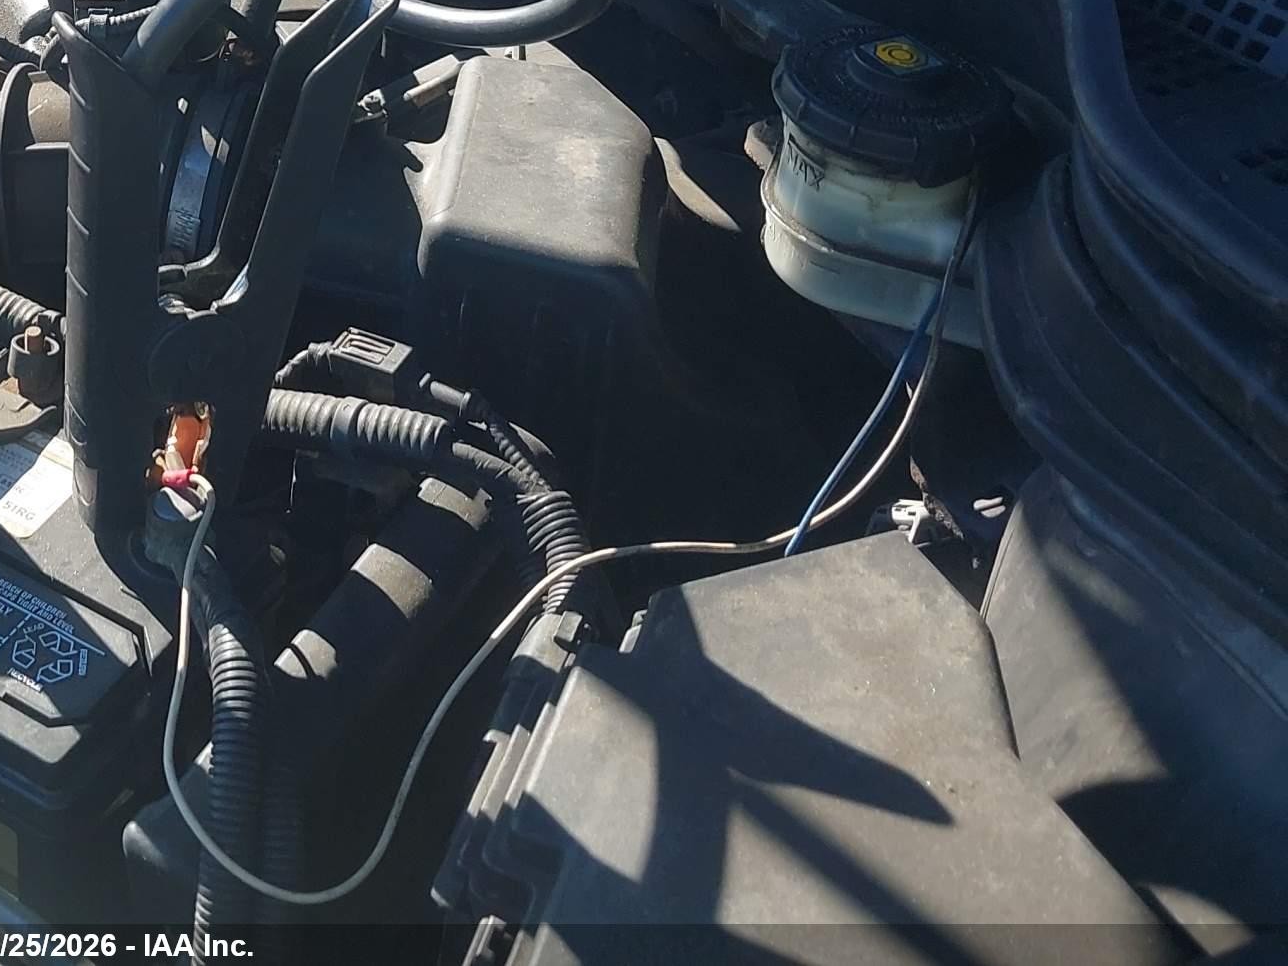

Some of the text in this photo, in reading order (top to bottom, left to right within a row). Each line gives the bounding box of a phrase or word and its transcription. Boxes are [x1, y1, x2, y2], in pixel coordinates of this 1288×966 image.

[2, 500, 36, 521] 51RG
[14, 598, 37, 612] TIGHT
[35, 609, 53, 621] AND
[19, 590, 33, 600] OF
[29, 596, 67, 619] CHILDREN
